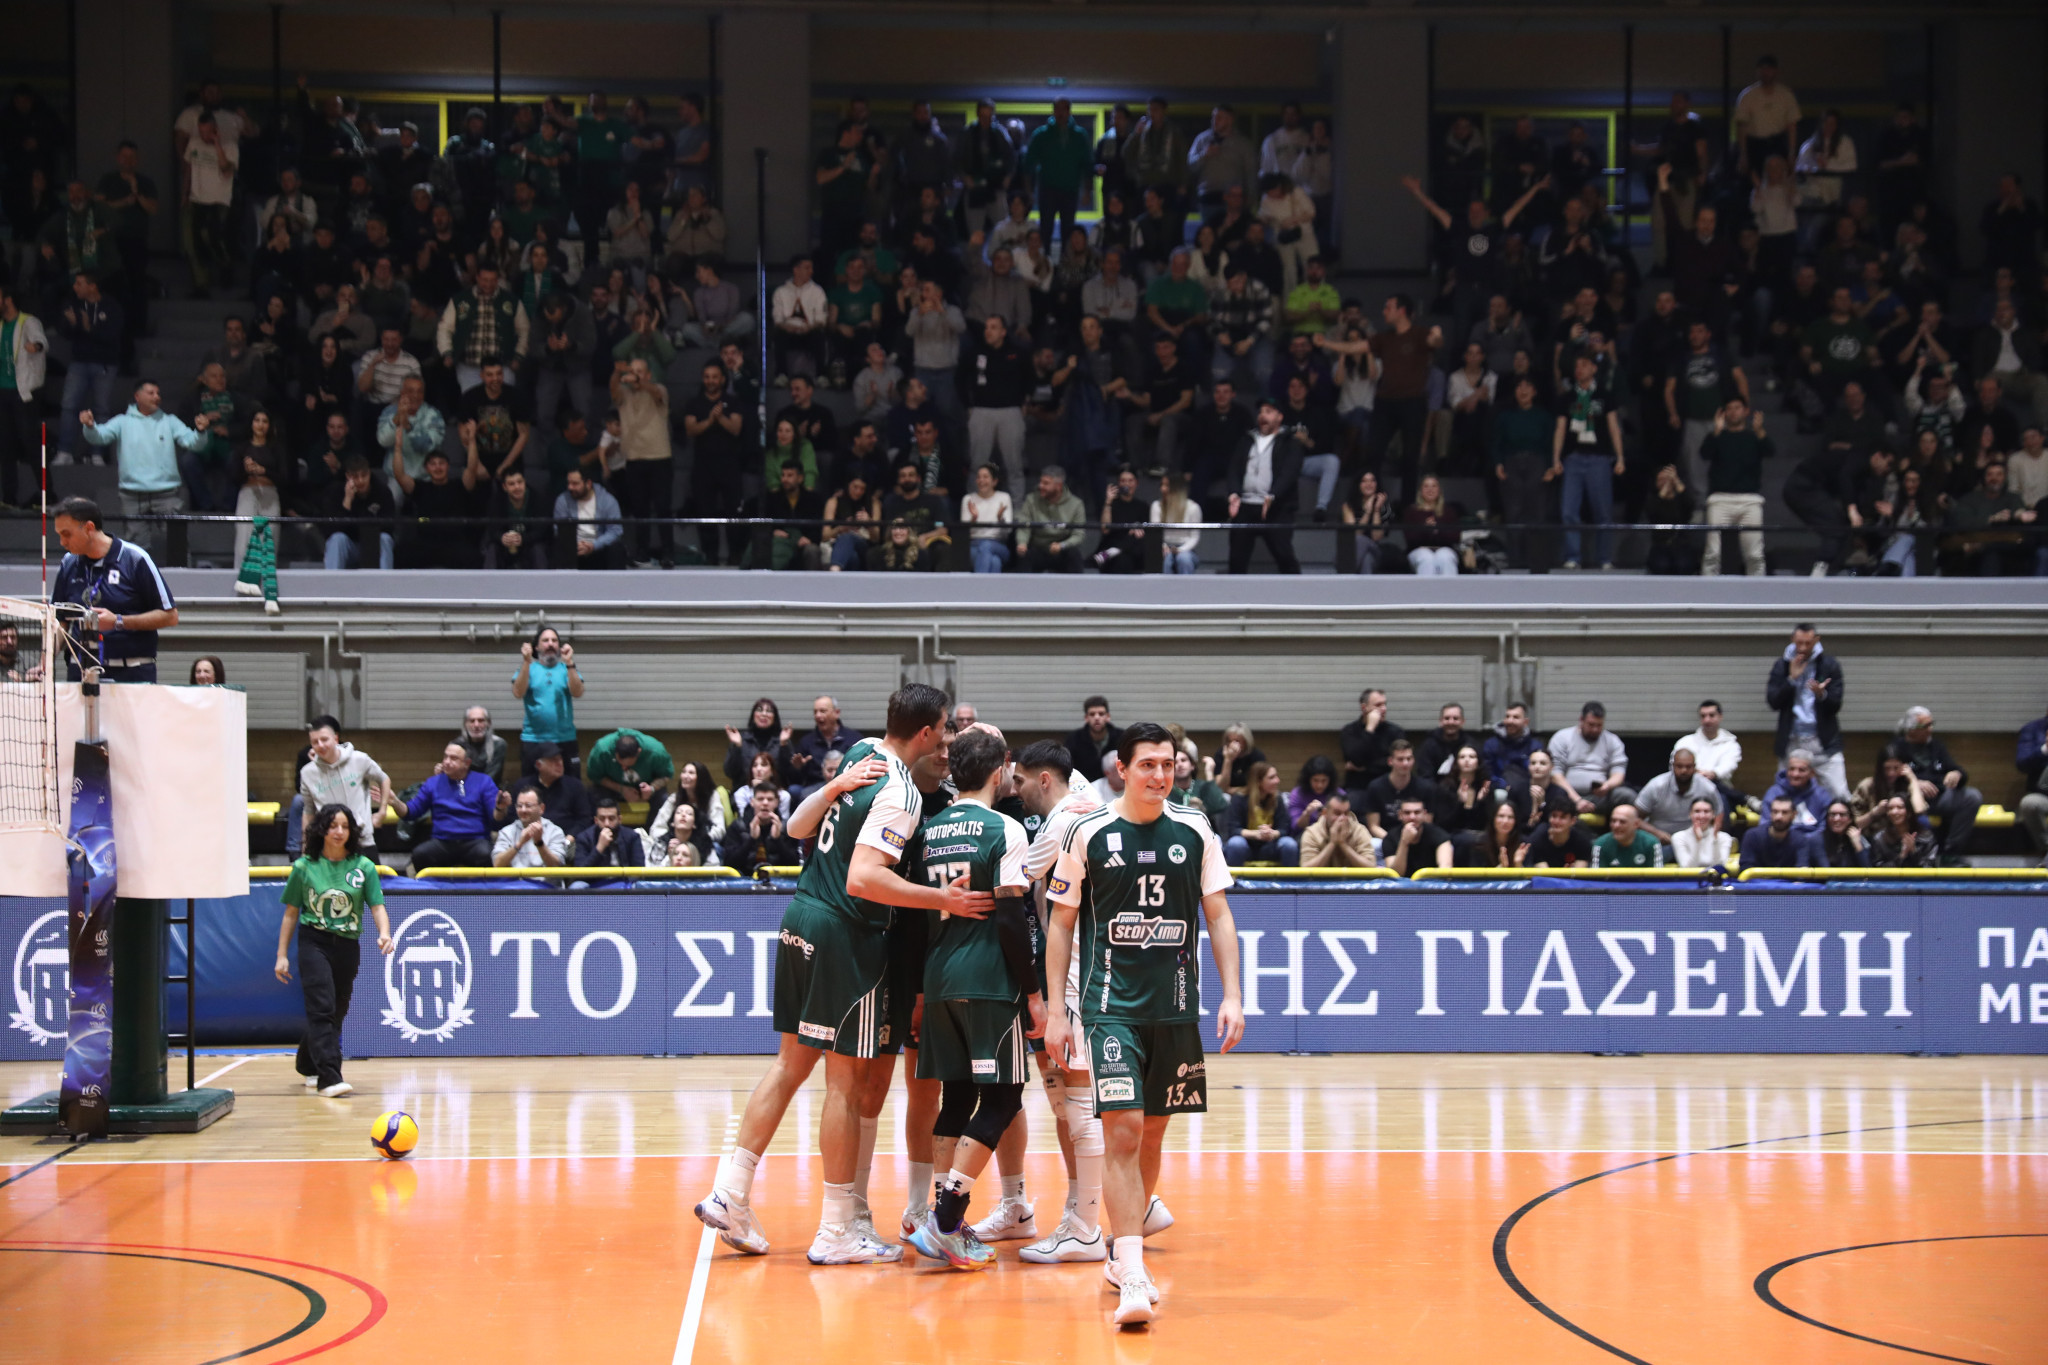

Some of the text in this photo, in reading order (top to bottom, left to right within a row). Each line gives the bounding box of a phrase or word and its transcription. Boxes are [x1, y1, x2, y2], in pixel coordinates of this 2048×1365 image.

[1137, 874, 1166, 907] 13
[491, 931, 638, 1019] ΤΟ
[1416, 929, 1913, 1017] ΓΙΑΣΕΜΗ
[1177, 966, 1188, 1012] globalsat
[1165, 1082, 1187, 1108] 13
